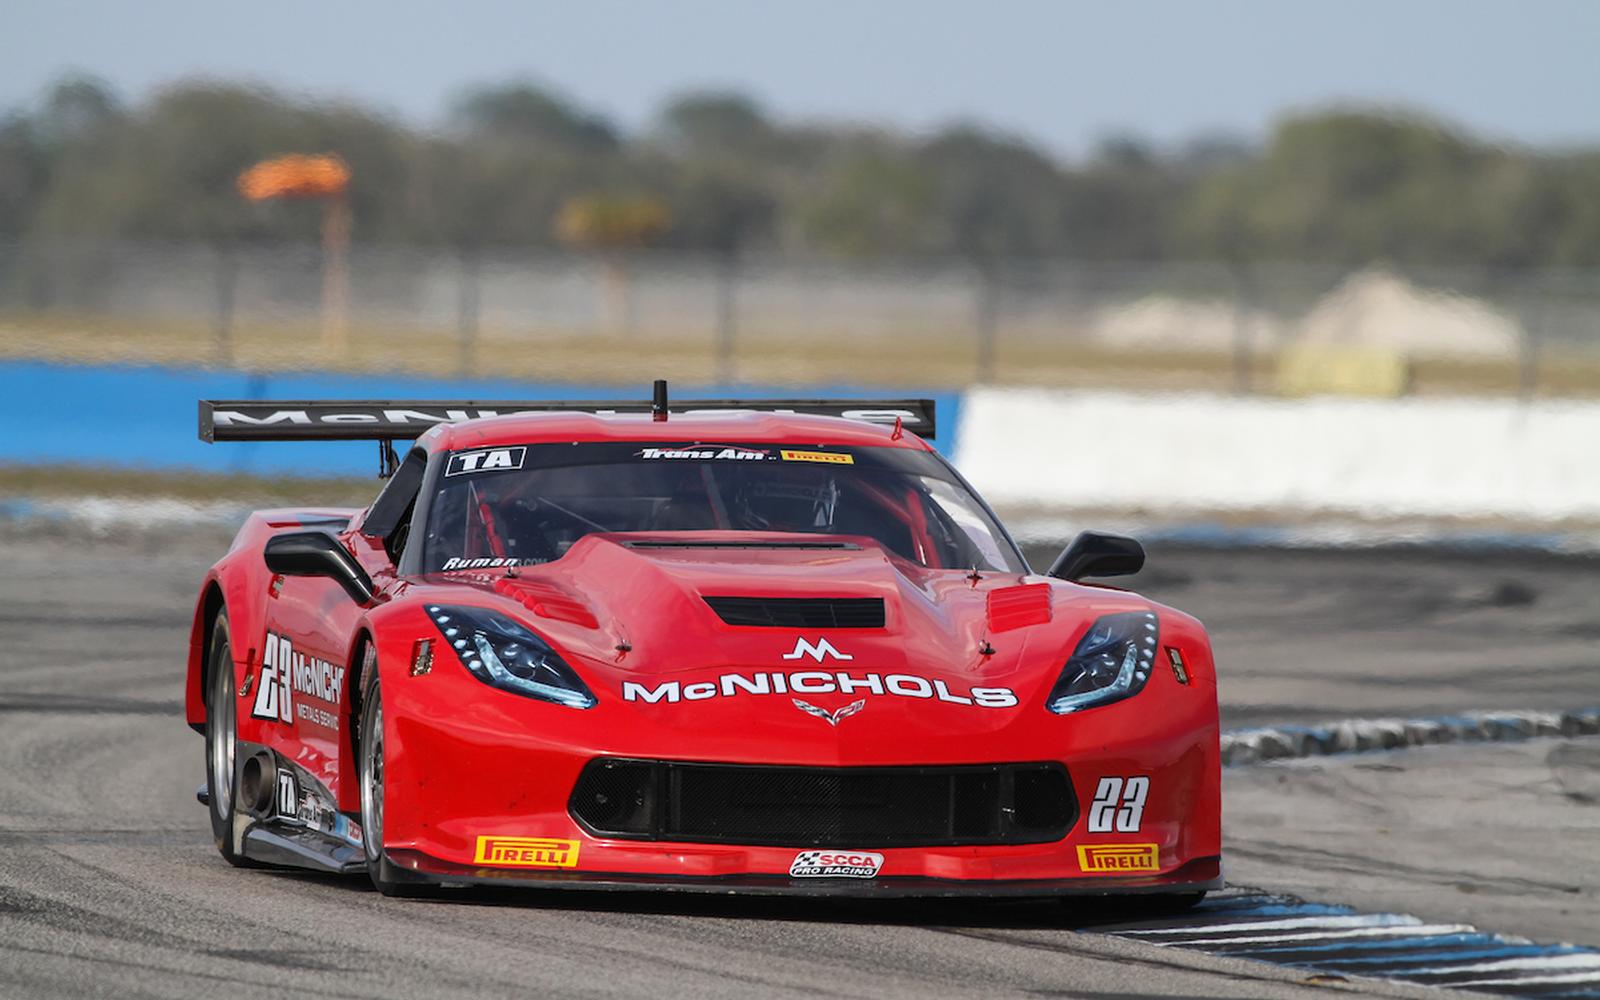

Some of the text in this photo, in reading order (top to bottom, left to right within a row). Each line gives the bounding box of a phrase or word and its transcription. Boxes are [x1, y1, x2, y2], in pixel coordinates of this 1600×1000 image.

[459, 450, 512, 471] TA
[641, 448, 714, 460] Trans
[715, 449, 764, 460] Am
[442, 557, 518, 570] Ruman
[252, 630, 293, 724] 23
[622, 672, 1019, 708] McNICHOLS
[280, 774, 296, 814] TA
[1087, 776, 1150, 833] 23
[483, 840, 570, 864] PIRELLI
[820, 855, 875, 867] SCCA
[1084, 848, 1153, 869] PIRELLI
[793, 867, 874, 875] PRO RACING
